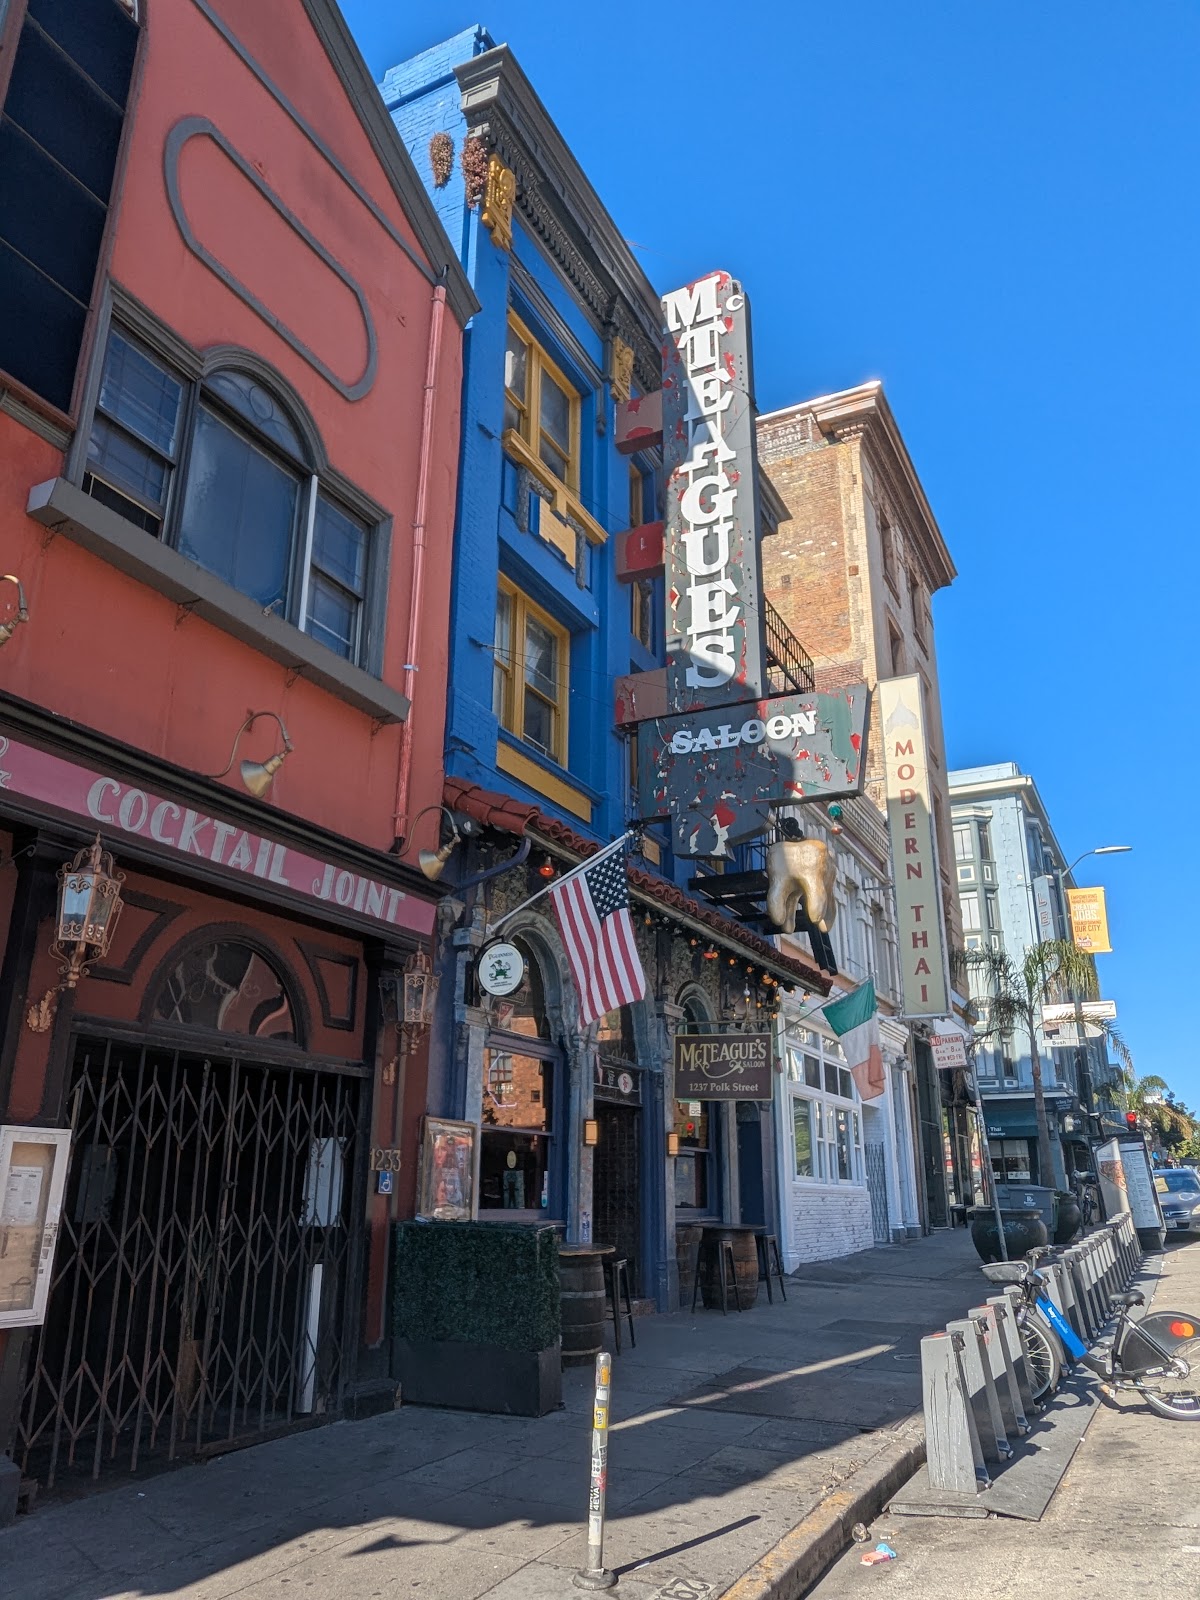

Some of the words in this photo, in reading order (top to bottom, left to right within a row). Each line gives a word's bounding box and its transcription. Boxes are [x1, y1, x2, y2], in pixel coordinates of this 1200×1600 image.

[669, 710, 817, 755] SALOON
[86, 776, 289, 886] COCKTAIL
[311, 863, 406, 924] JOINT
[894, 739, 923, 880] MODERN
[910, 904, 931, 1003] THAI
[931, 1036, 941, 1046] NO
[941, 1036, 963, 1044] PARKING
[743, 1060, 766, 1068] SALOON
[689, 1083, 708, 1091] 1237
[710, 1083, 730, 1091] Polk
[732, 1082, 759, 1092] Street
[370, 1148, 402, 1172] 1233
[592, 1487, 600, 1511] 4EVA
